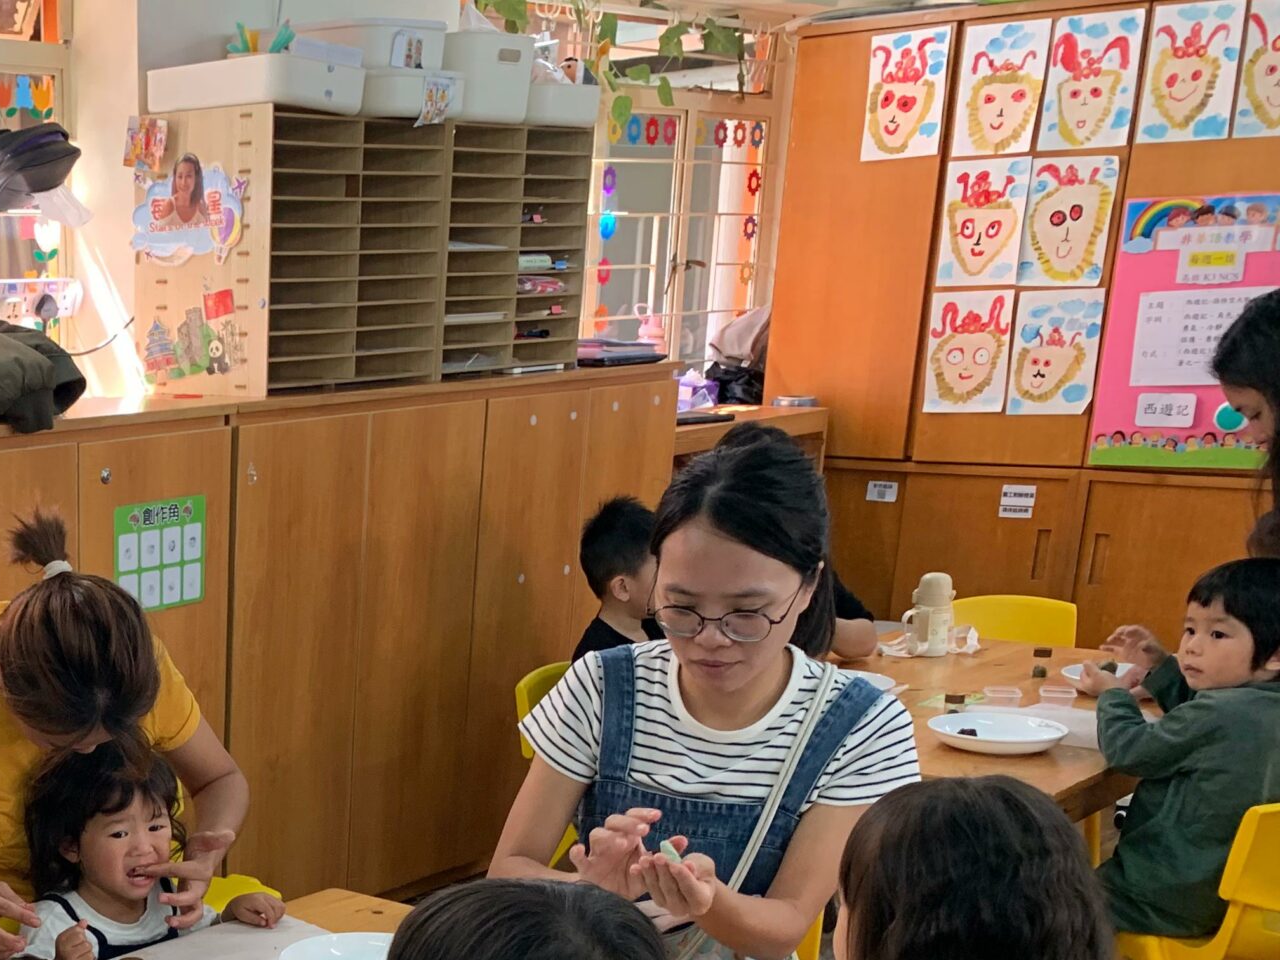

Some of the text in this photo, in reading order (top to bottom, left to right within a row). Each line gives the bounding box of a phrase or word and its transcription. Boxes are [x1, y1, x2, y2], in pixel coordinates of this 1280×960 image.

[1144, 403, 1190, 417] 西遊記
[142, 503, 179, 526] 創作角
